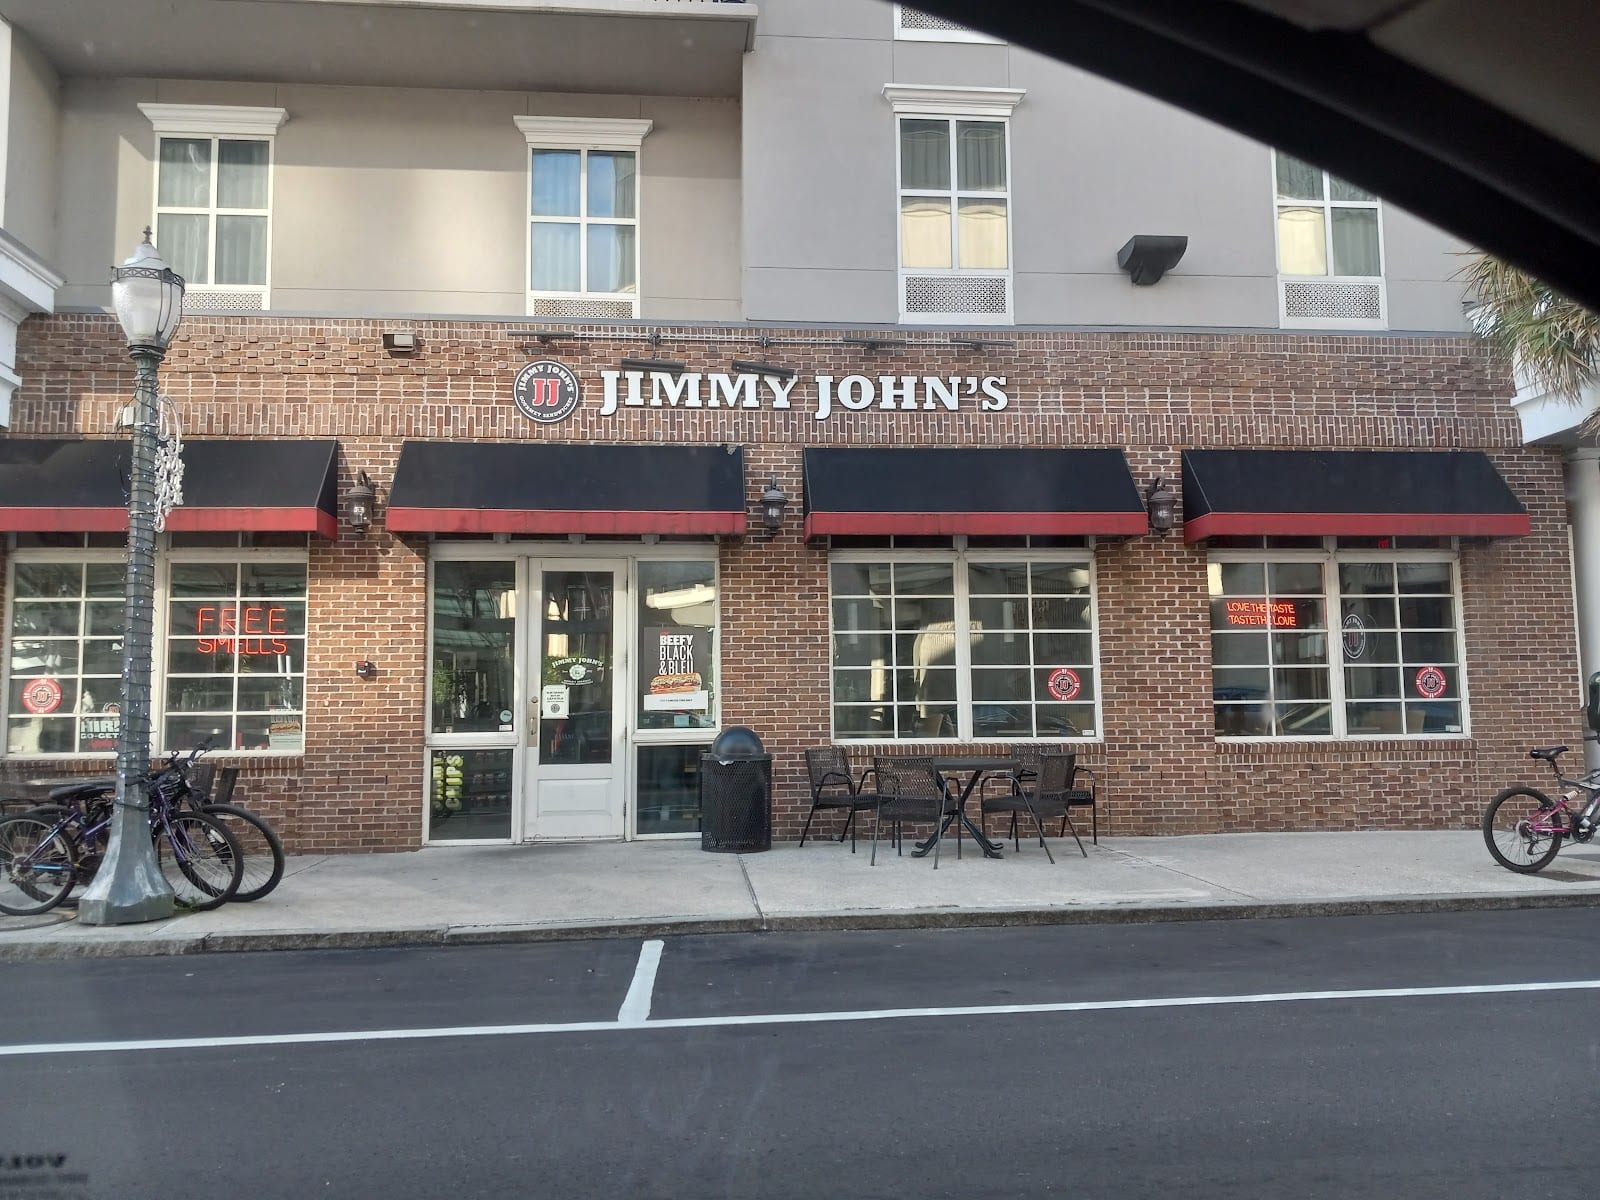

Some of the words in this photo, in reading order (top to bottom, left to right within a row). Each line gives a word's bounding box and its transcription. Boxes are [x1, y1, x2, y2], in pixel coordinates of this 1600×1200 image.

[518, 364, 544, 391] JIMMY
[546, 364, 575, 393] JOHN'S
[532, 378, 561, 407] JJ
[600, 370, 799, 416] JIMMY
[815, 374, 1009, 420] JOHN'S
[1226, 602, 1250, 612] LOVE
[1250, 603, 1267, 613] THE
[1269, 604, 1295, 614] TASTE
[197, 607, 286, 634] FREE
[1228, 615, 1257, 625] TASTE
[1272, 616, 1297, 626] LOVE
[197, 636, 288, 655] SMELLS
[659, 634, 694, 646] BEEFY
[659, 645, 694, 661] BLACK
[551, 657, 577, 669] JIMMY
[658, 660, 667, 676] &
[668, 660, 694, 675] BLEU
[445, 754, 464, 812] CHIPS
